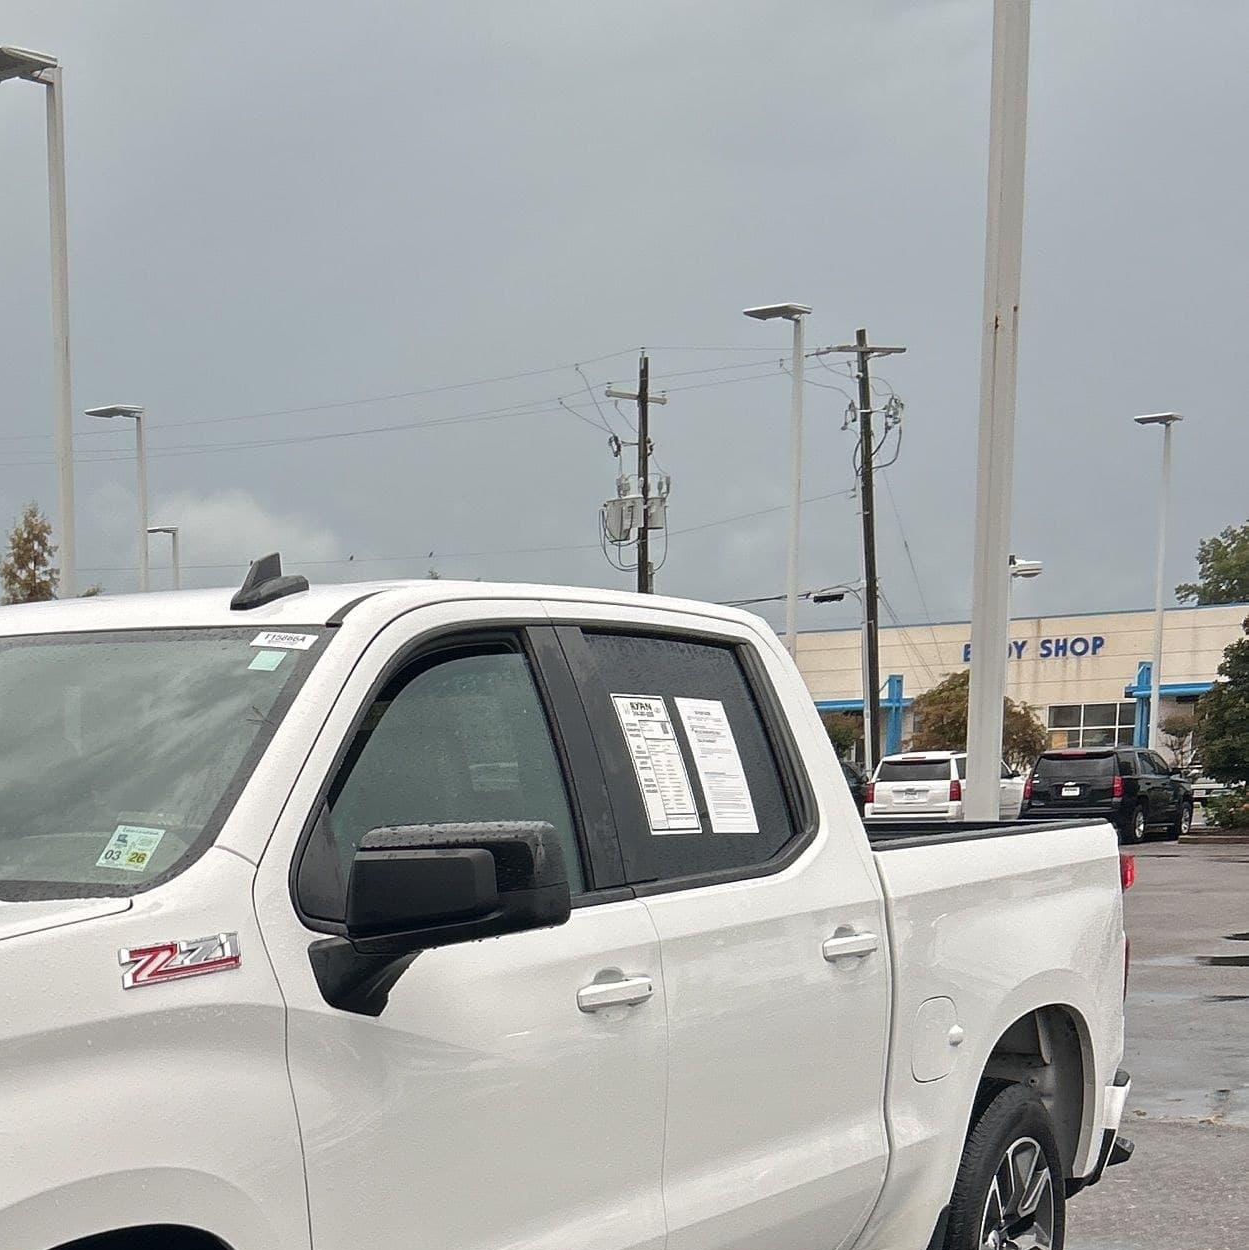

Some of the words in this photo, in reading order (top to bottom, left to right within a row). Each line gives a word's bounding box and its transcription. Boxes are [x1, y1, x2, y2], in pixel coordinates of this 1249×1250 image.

[963, 639, 1028, 662] BY
[1039, 635, 1105, 658] SHOP
[104, 849, 122, 861] 03
[127, 852, 147, 864] 26
[118, 931, 242, 989] Z71
